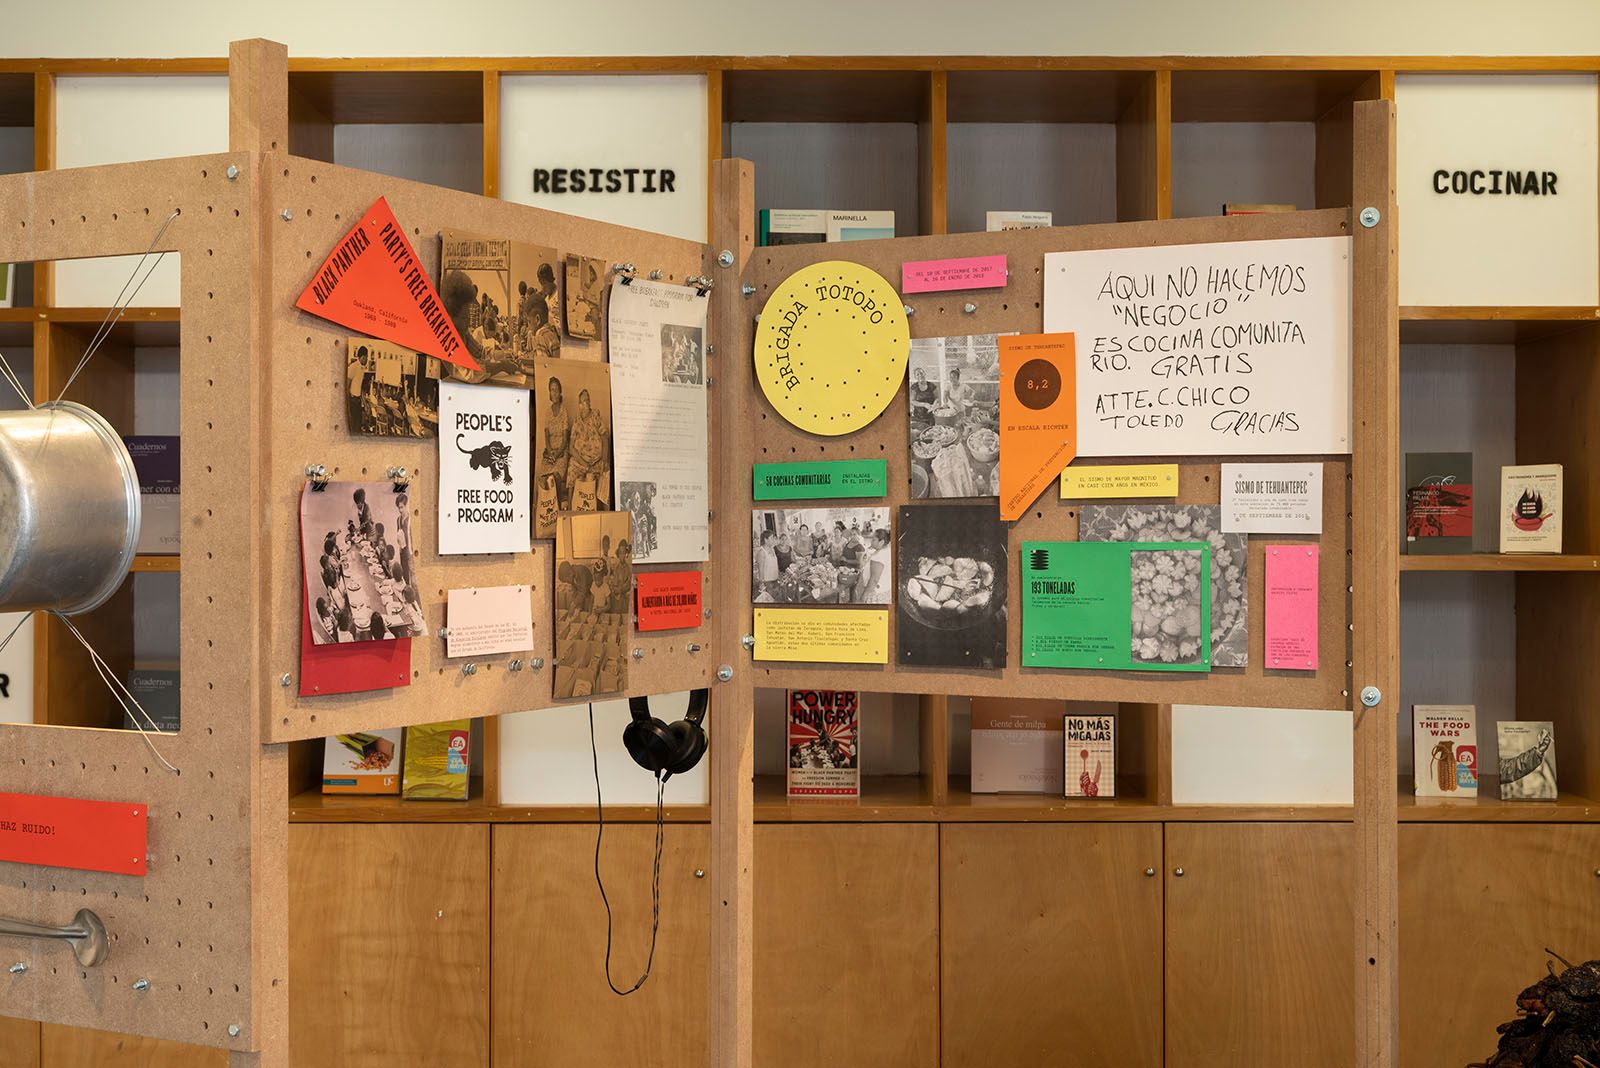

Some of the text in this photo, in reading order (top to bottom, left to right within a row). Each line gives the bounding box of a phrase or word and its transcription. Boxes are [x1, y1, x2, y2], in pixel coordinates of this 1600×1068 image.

[533, 169, 675, 193] RESISTIR
[1433, 170, 1557, 195] COCINAR
[313, 227, 371, 305] BLACK PANTHER
[379, 222, 460, 357] PARTY'S FREE BREAKFAST
[1097, 264, 1306, 301] AQUI NO HACEMOS
[353, 300, 408, 323] Oakland, California
[776, 285, 883, 391] BRIGADA TOTOPO
[1210, 320, 1305, 349] COMUNITA
[1090, 351, 1253, 378] RIO. GRATIS
[1027, 379, 1049, 390] 8,2
[456, 413, 512, 432] PEOPLE'S
[1100, 410, 1300, 436] TOLEDO GRACIAS
[774, 475, 794, 486] COCINAS
[795, 474, 831, 485] COMUNITARIAS
[1235, 481, 1308, 494] SISMO DE TEHUANTEPEC
[458, 489, 513, 504] FREE FOOD
[458, 508, 513, 523] PROGRAM
[1031, 582, 1075, 594] 193 TONELADAS
[134, 678, 172, 686] Cuadernos
[793, 691, 856, 707] POWER
[793, 709, 855, 724] HUNGRY
[1068, 717, 1110, 730] NO MÁS
[991, 719, 1047, 730] Gente de milpa
[1068, 731, 1111, 741] MIGAJAS
[0, 821, 55, 835] HAZ RUIDO!
